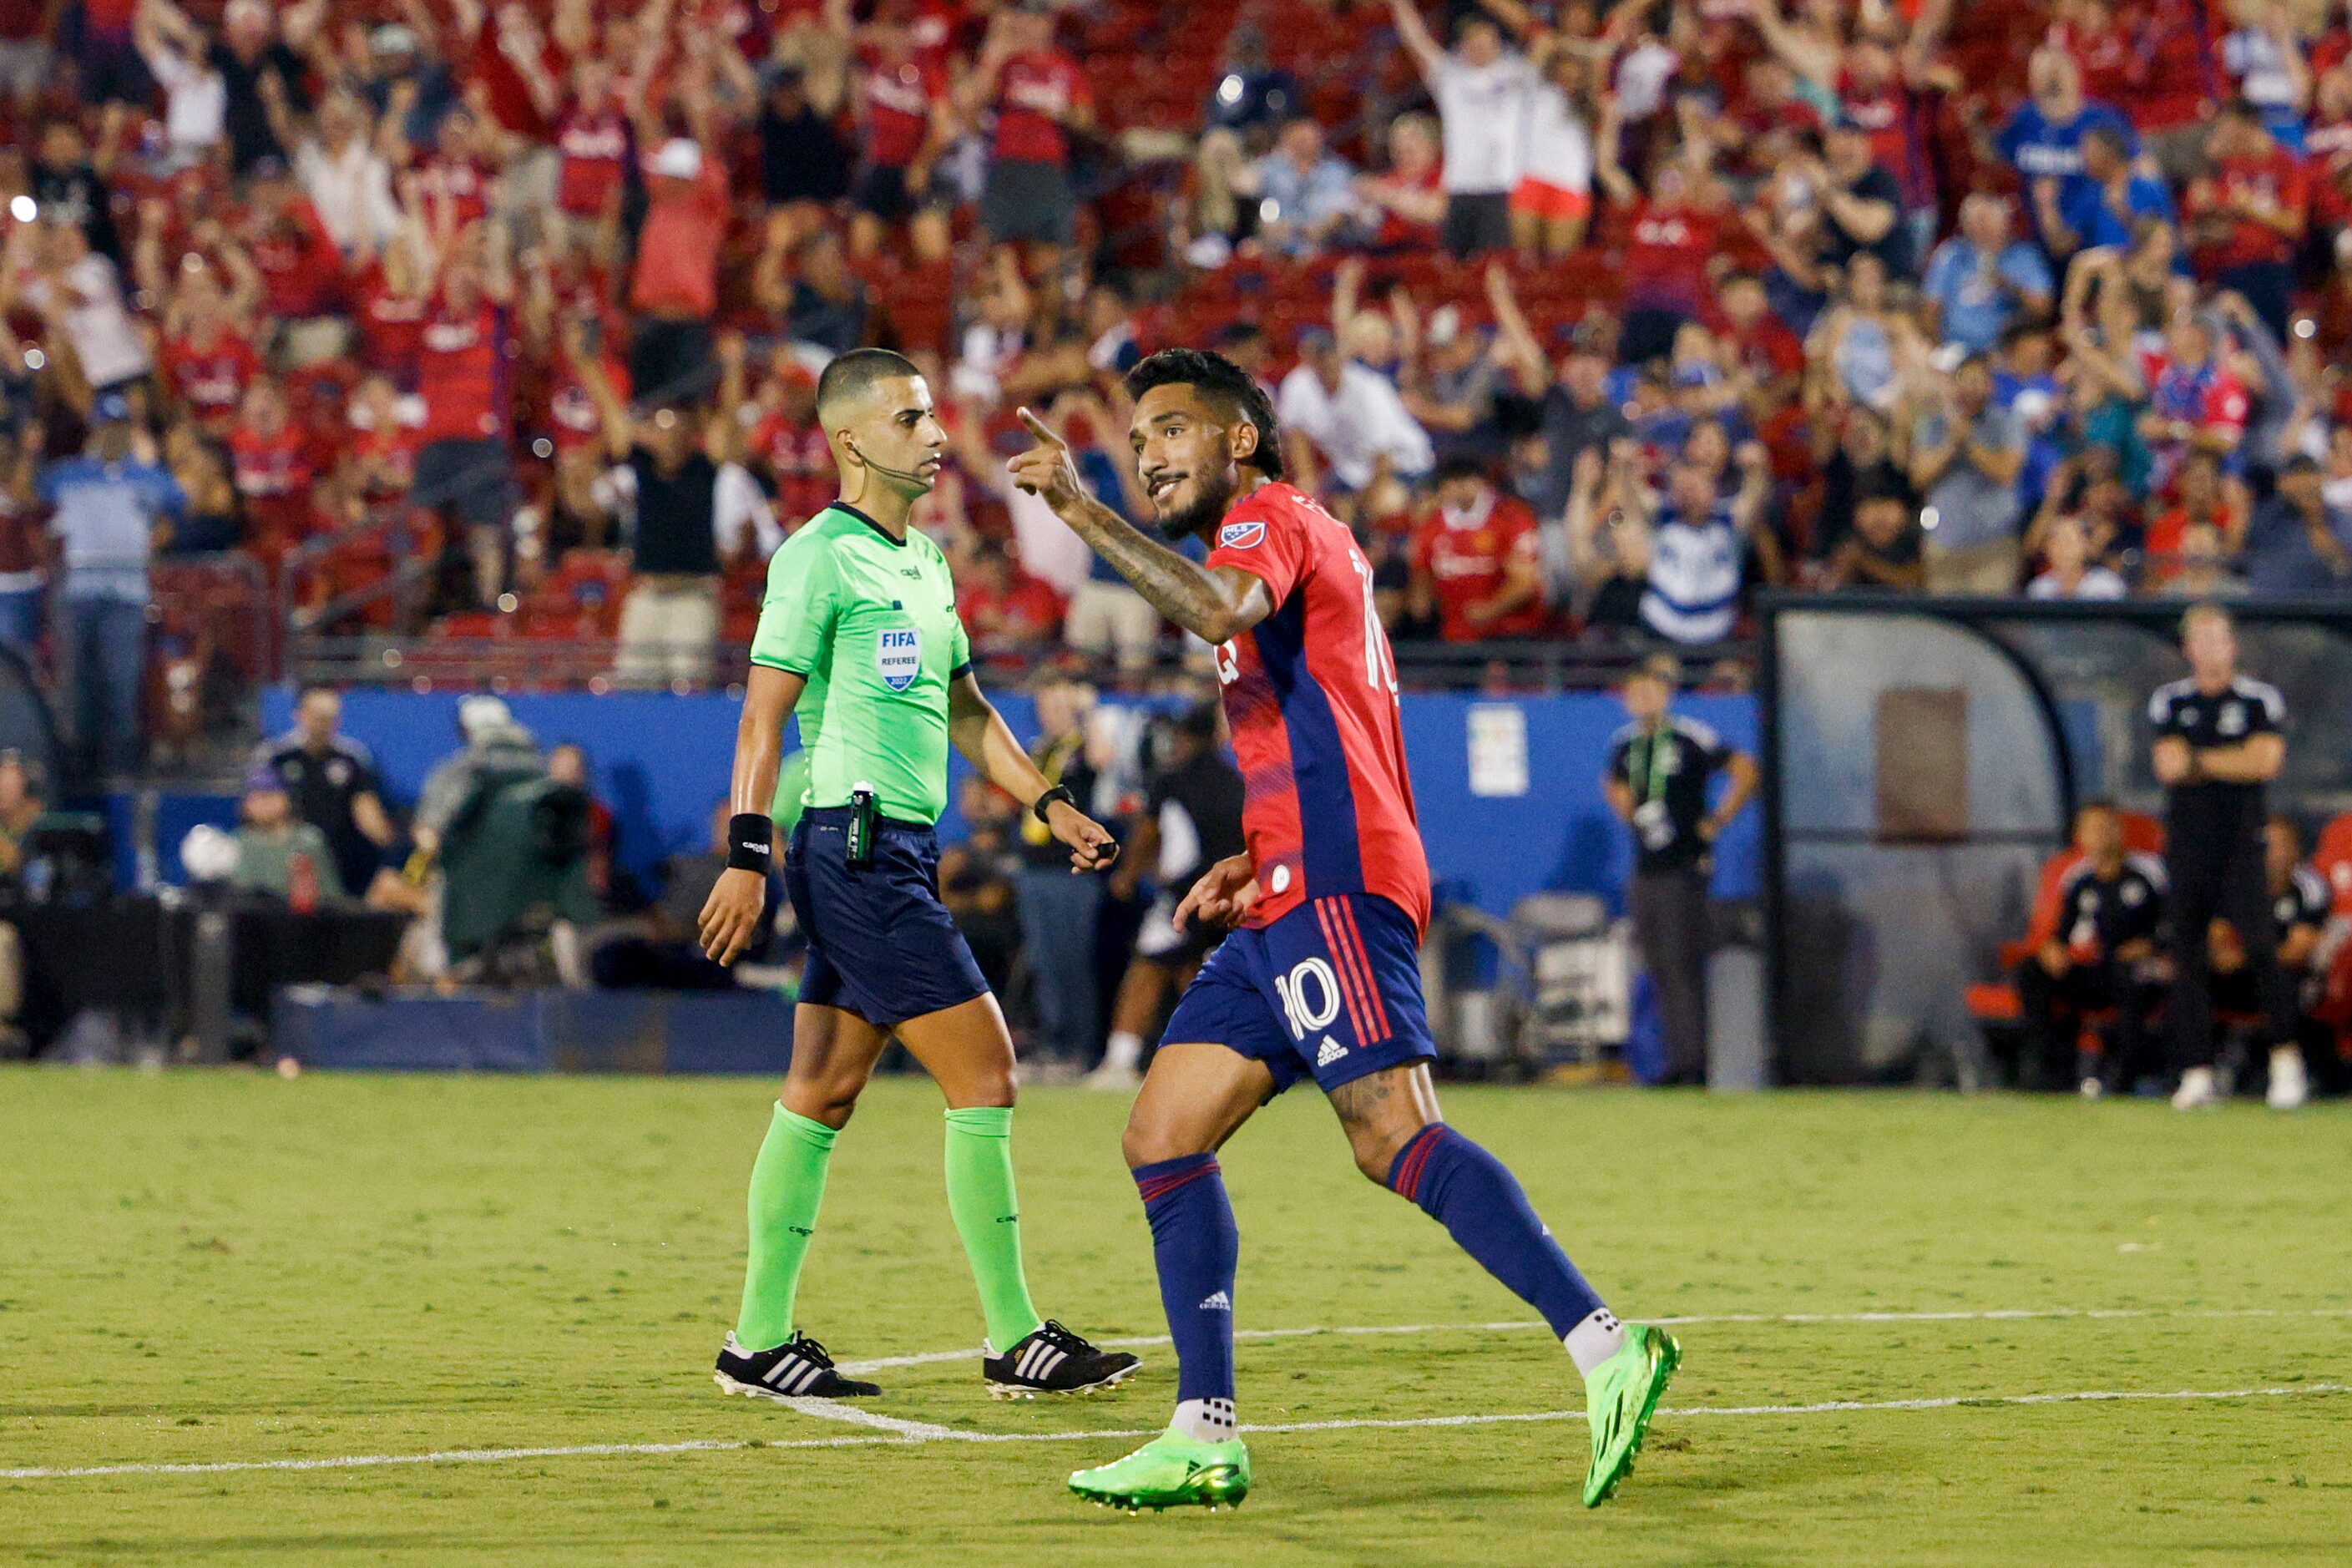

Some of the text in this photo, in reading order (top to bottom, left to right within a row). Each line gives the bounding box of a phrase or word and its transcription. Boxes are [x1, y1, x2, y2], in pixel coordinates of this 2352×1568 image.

[1225, 525, 1248, 534] MLS
[882, 632, 916, 648] FIFA
[882, 656, 916, 666] REFEREE
[1274, 957, 1341, 1041] 10
[1318, 1046, 1349, 1067] adidas
[1199, 1302, 1231, 1312] adidas
